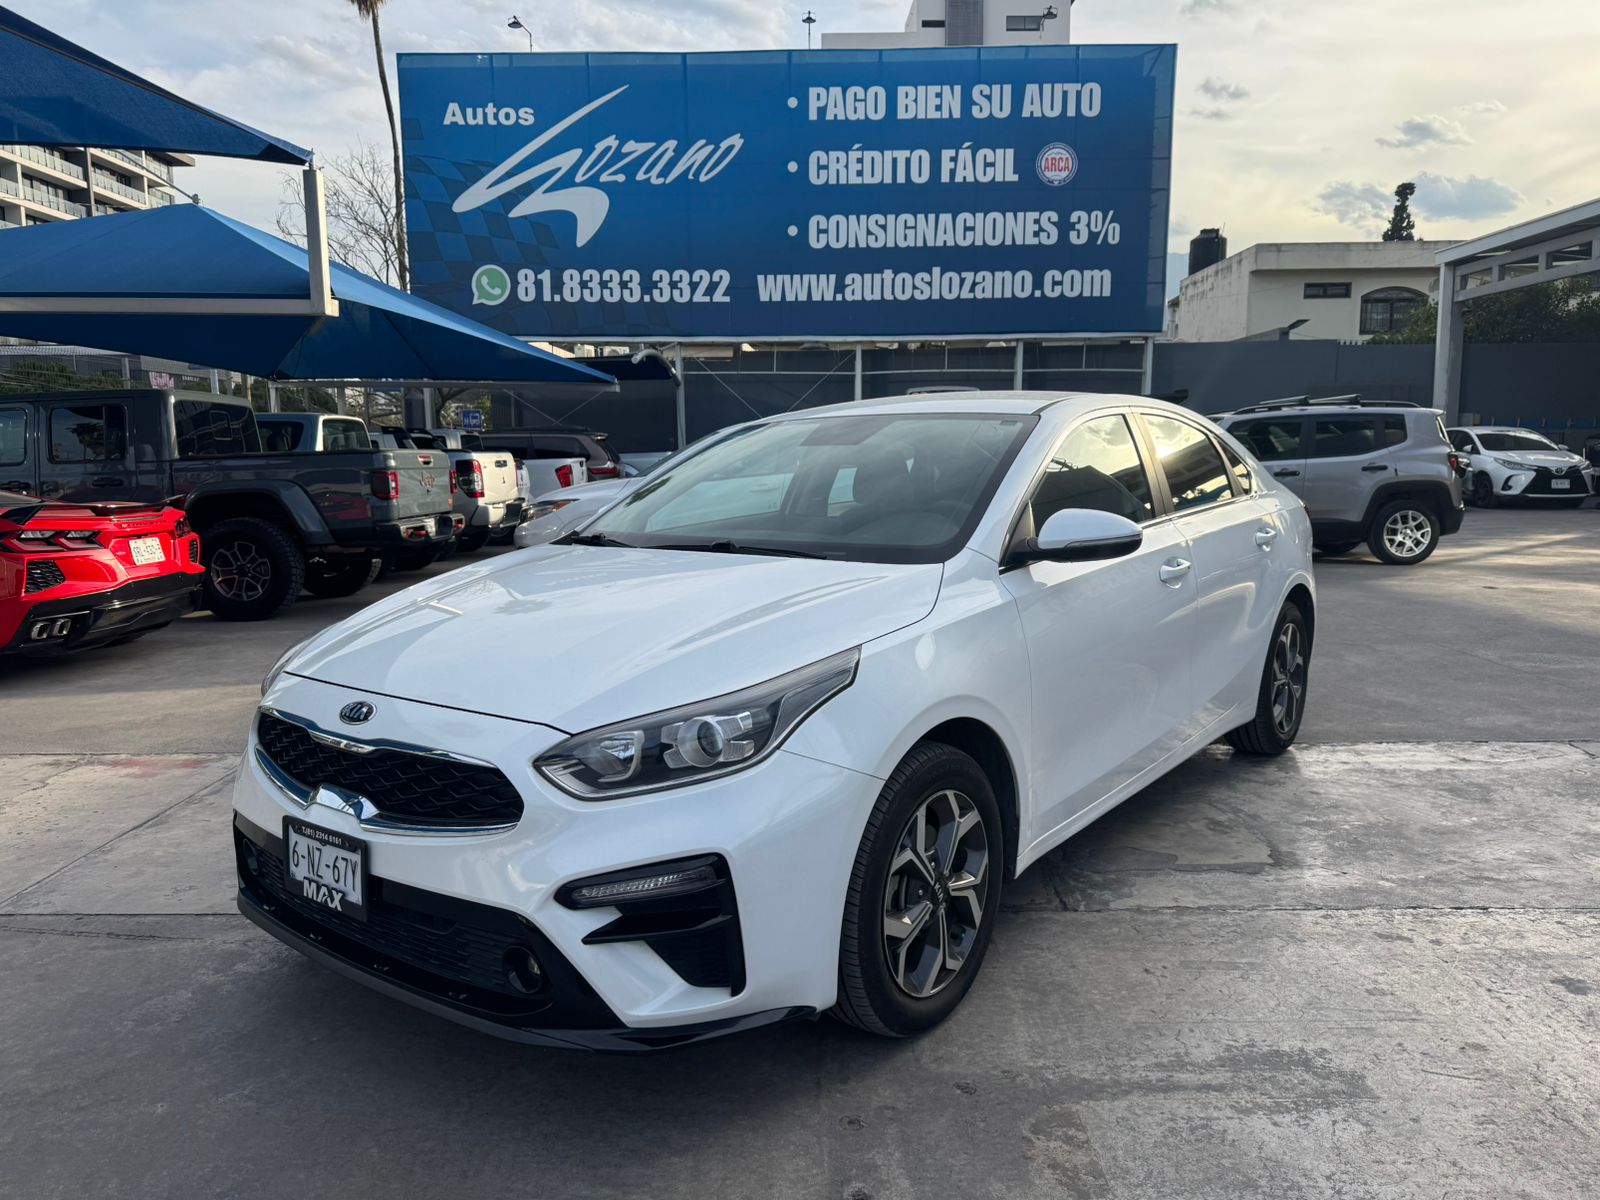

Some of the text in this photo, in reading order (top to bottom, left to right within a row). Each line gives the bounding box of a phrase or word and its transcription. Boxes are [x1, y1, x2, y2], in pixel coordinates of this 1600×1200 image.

[443, 102, 535, 126] Autos
[808, 83, 1102, 121] PAGO BIEN SU AUTO
[808, 142, 1019, 185] CRÉDITO FÁCIL
[1043, 156, 1070, 173] ARCA
[808, 210, 1121, 249] CONSIGNACIONES 3%
[517, 268, 731, 303] 81.8333.3322
[756, 267, 1112, 302] www.autoslozano.com
[292, 840, 357, 893] 6-NZ-67Y
[303, 879, 343, 912] MAX
